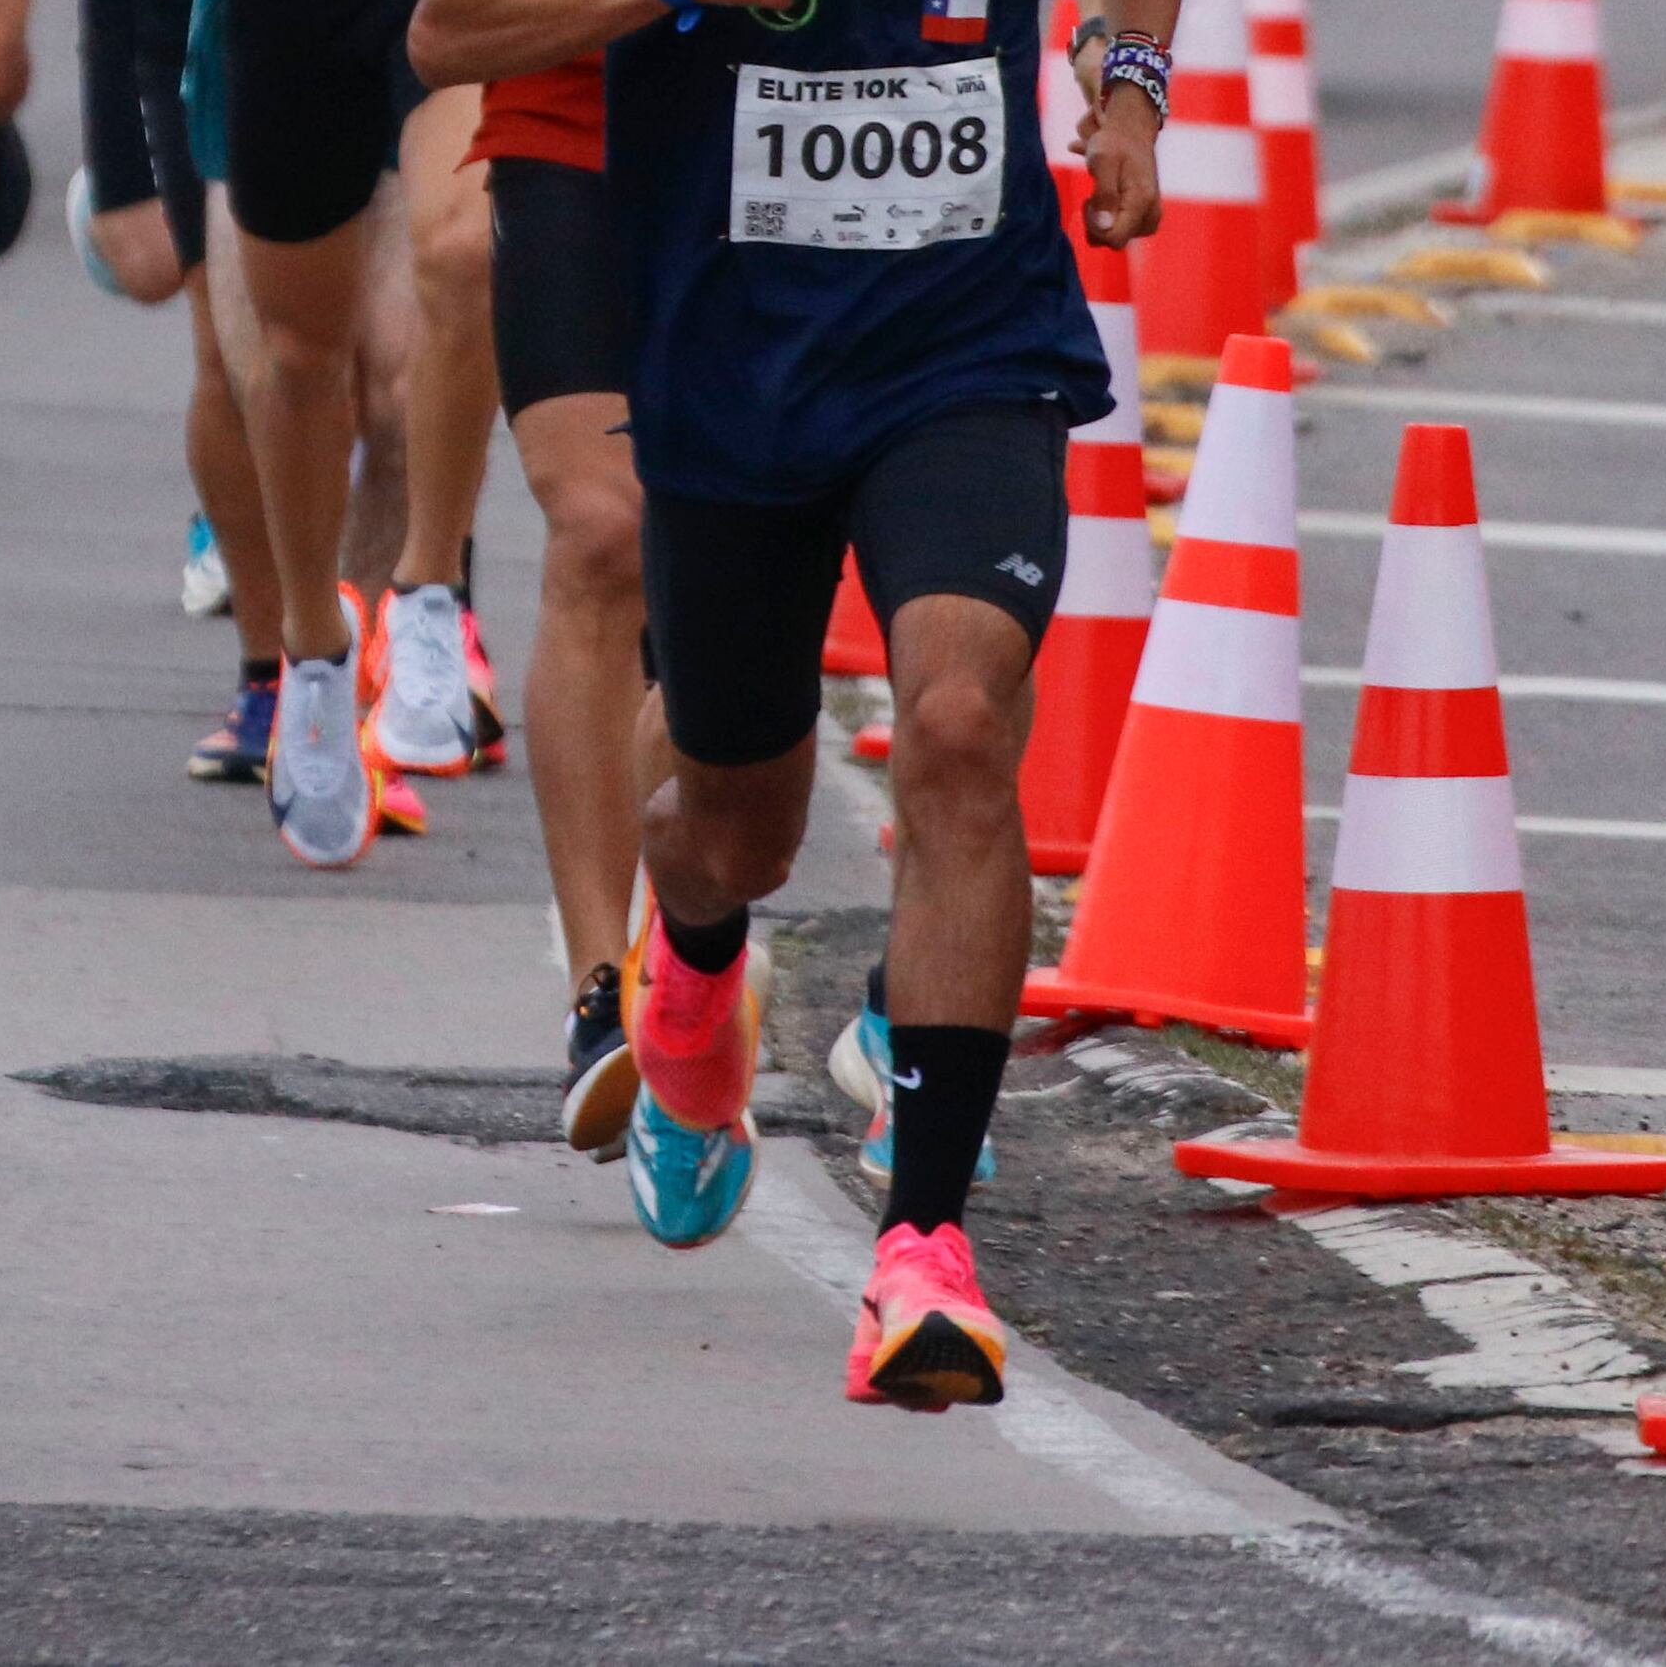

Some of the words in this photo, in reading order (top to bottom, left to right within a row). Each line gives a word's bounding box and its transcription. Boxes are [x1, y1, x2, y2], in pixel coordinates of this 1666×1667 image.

[756, 77, 843, 102] ELITE
[852, 77, 909, 99] 10K
[756, 116, 988, 182] 10008
